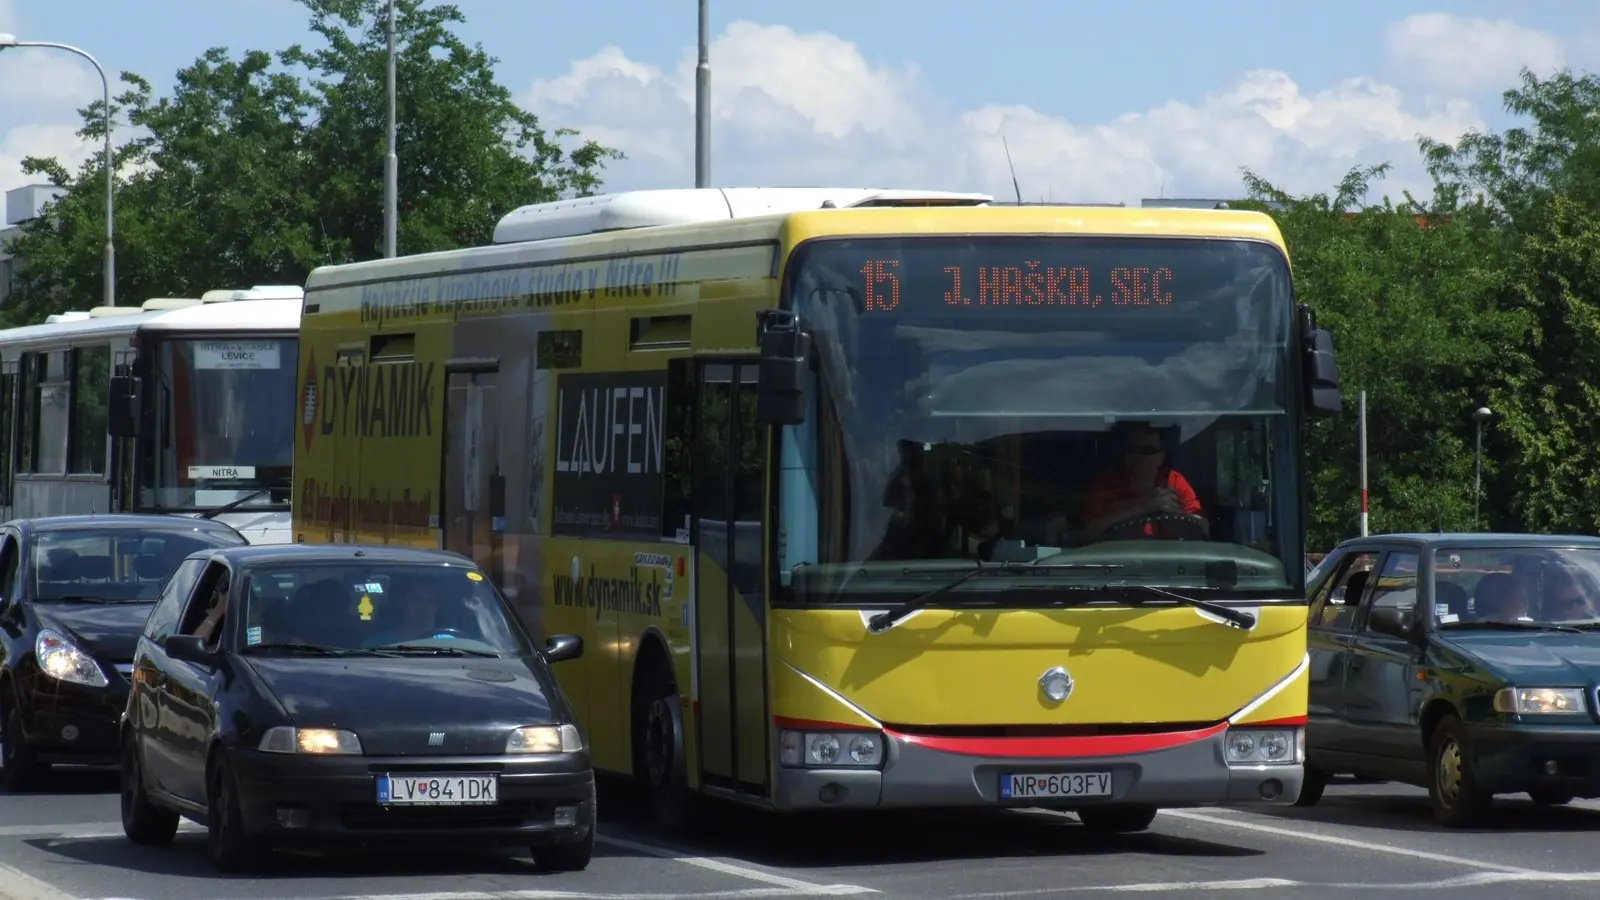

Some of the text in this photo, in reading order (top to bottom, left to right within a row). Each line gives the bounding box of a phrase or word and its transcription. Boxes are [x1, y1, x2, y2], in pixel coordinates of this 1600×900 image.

[588, 267, 599, 300] v
[605, 256, 653, 298] Nitre
[860, 260, 900, 311] 15
[1111, 267, 1173, 305] SEC
[321, 361, 435, 438] DYNAMIK
[556, 386, 664, 481] LAUFEN
[212, 468, 239, 477] NITRA
[553, 563, 662, 620] www.dynamik.sk
